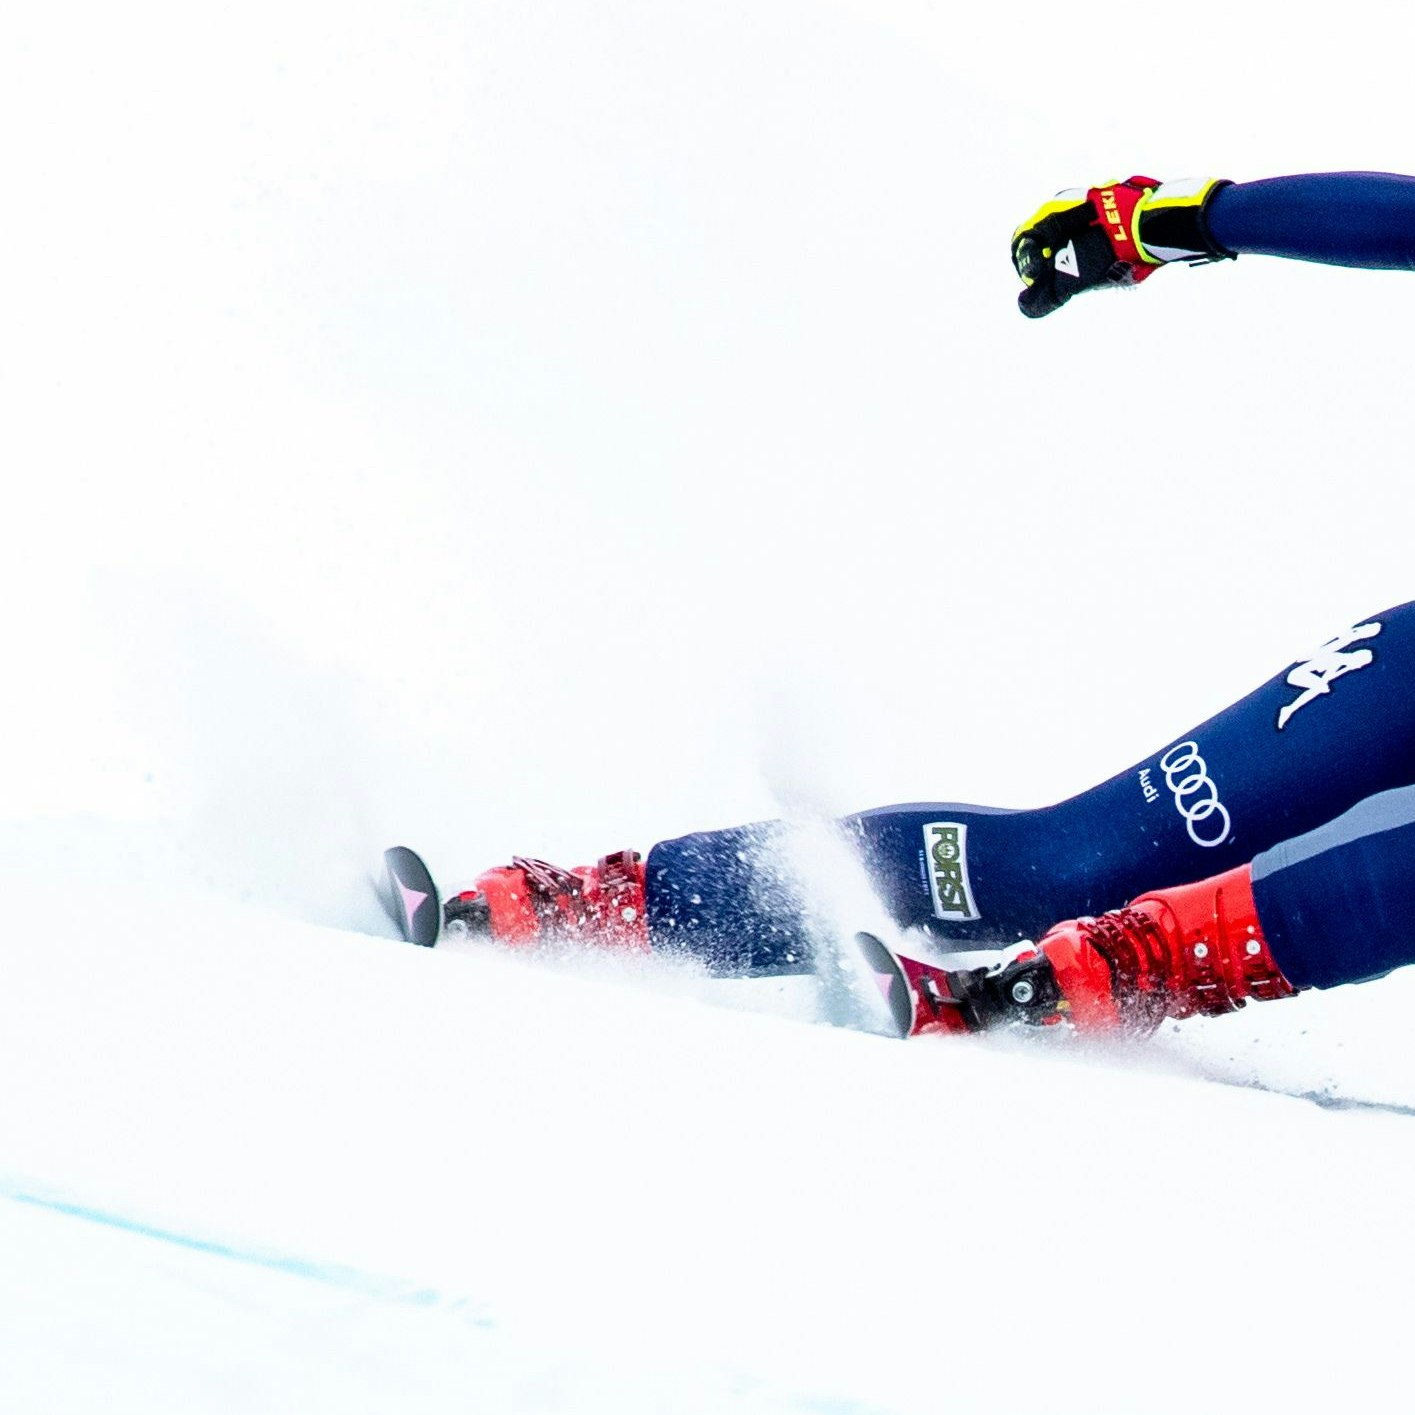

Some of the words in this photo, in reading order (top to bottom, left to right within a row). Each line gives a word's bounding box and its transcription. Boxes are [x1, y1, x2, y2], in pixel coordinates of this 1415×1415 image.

[1100, 190, 1128, 241] LEKI
[1138, 767, 1160, 803] Audi
[932, 826, 972, 918] FORST
